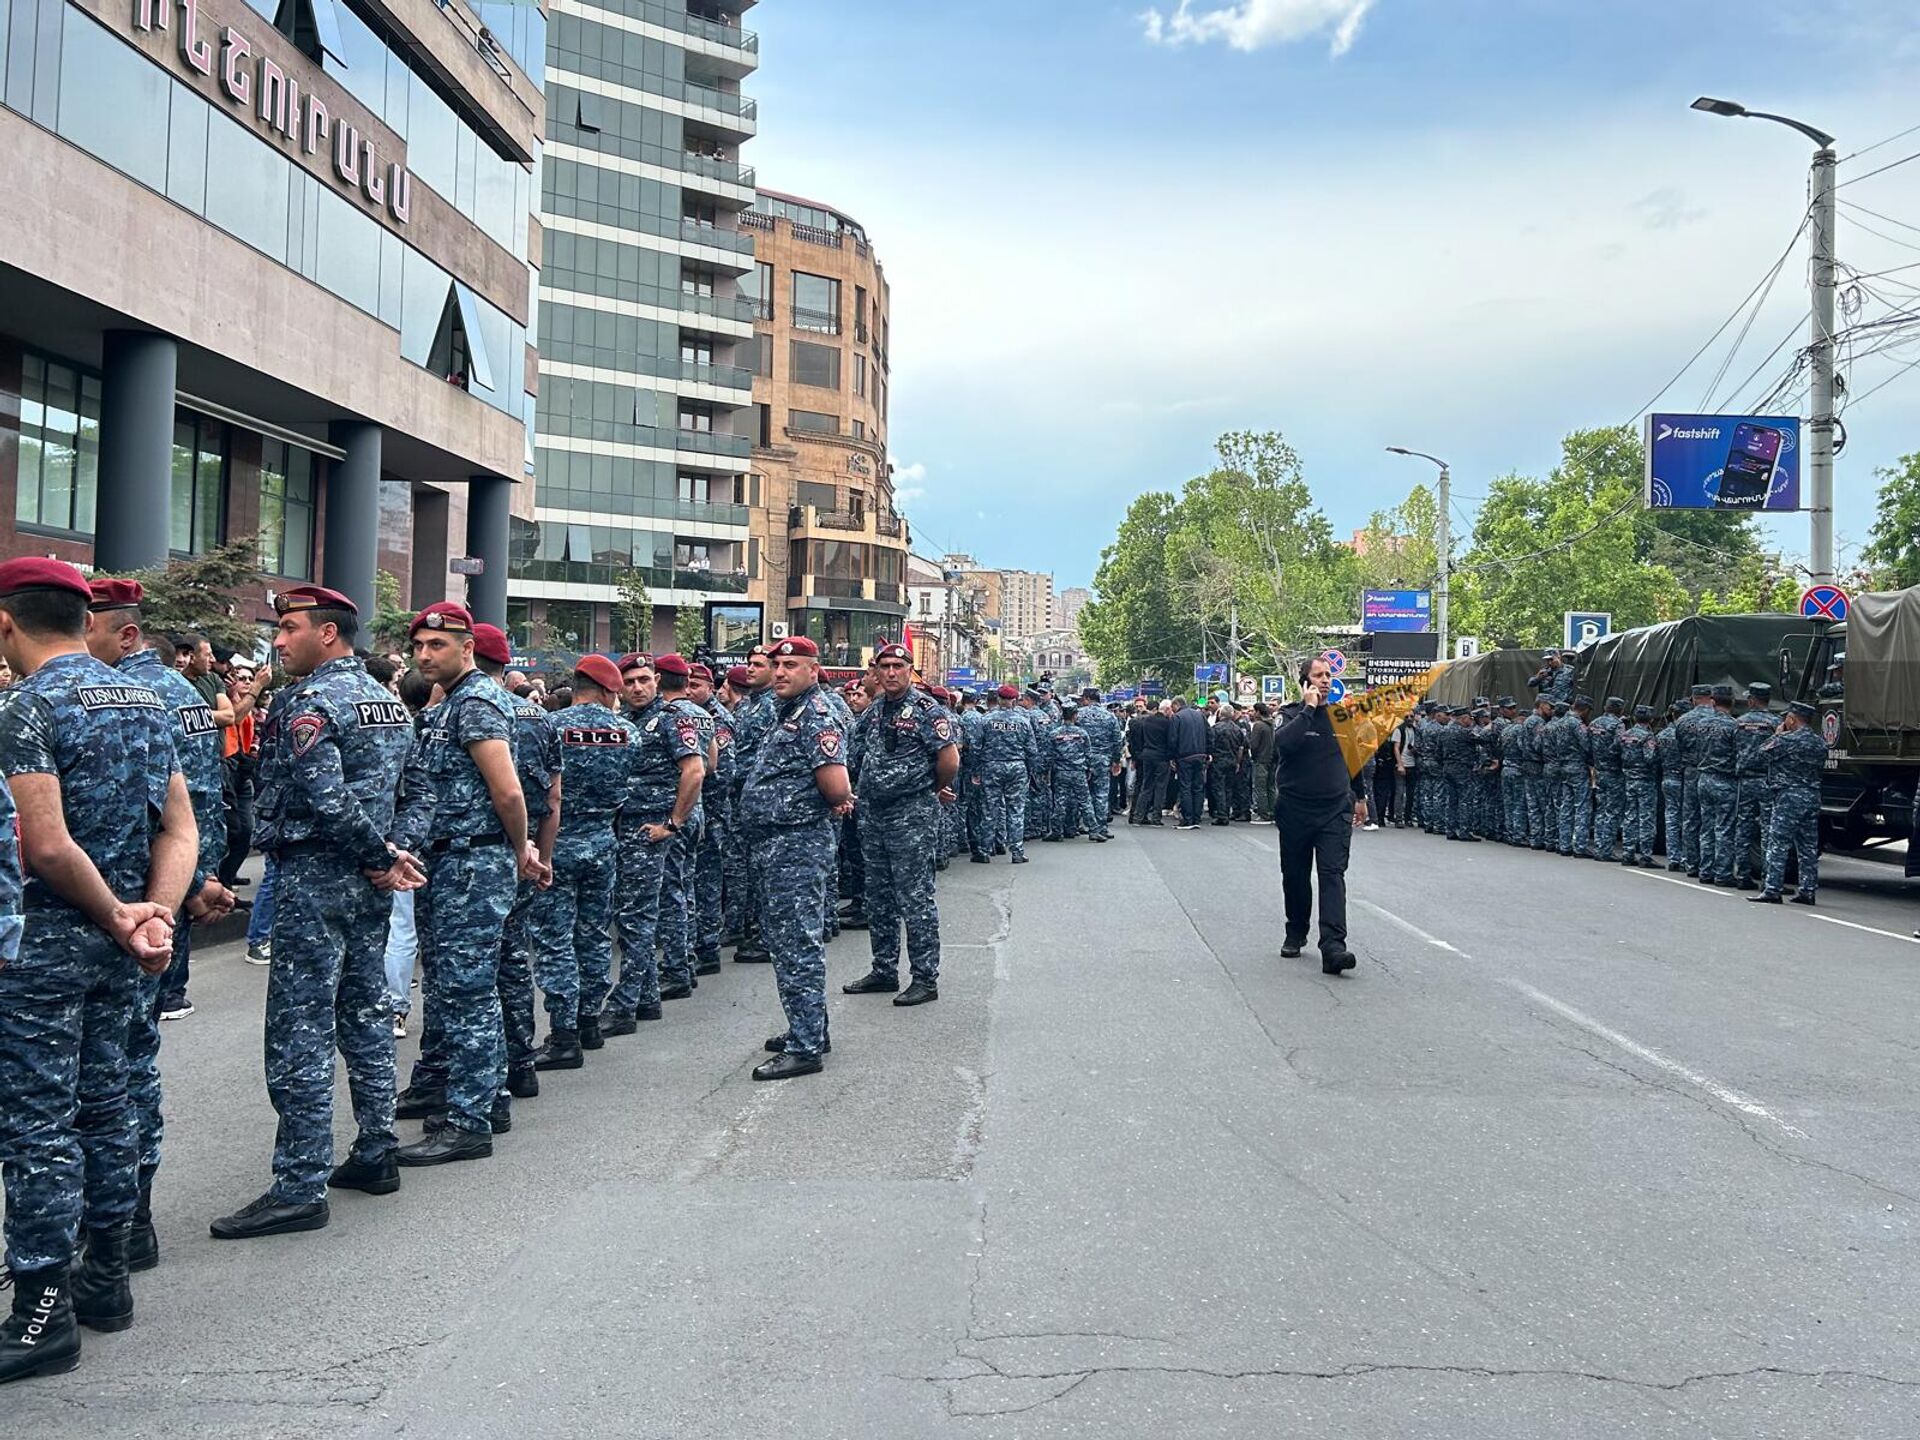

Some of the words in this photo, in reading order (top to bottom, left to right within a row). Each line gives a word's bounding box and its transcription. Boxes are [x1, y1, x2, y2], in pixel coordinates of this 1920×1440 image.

[1673, 427, 1721, 440] fastshift
[734, 656, 748, 664] PALA
[1368, 660, 1431, 668] ԱՎՏՈԿԱՅԱՆԱՏԵ
[1270, 682, 1279, 692] P
[21, 1286, 59, 1346] POLICE
